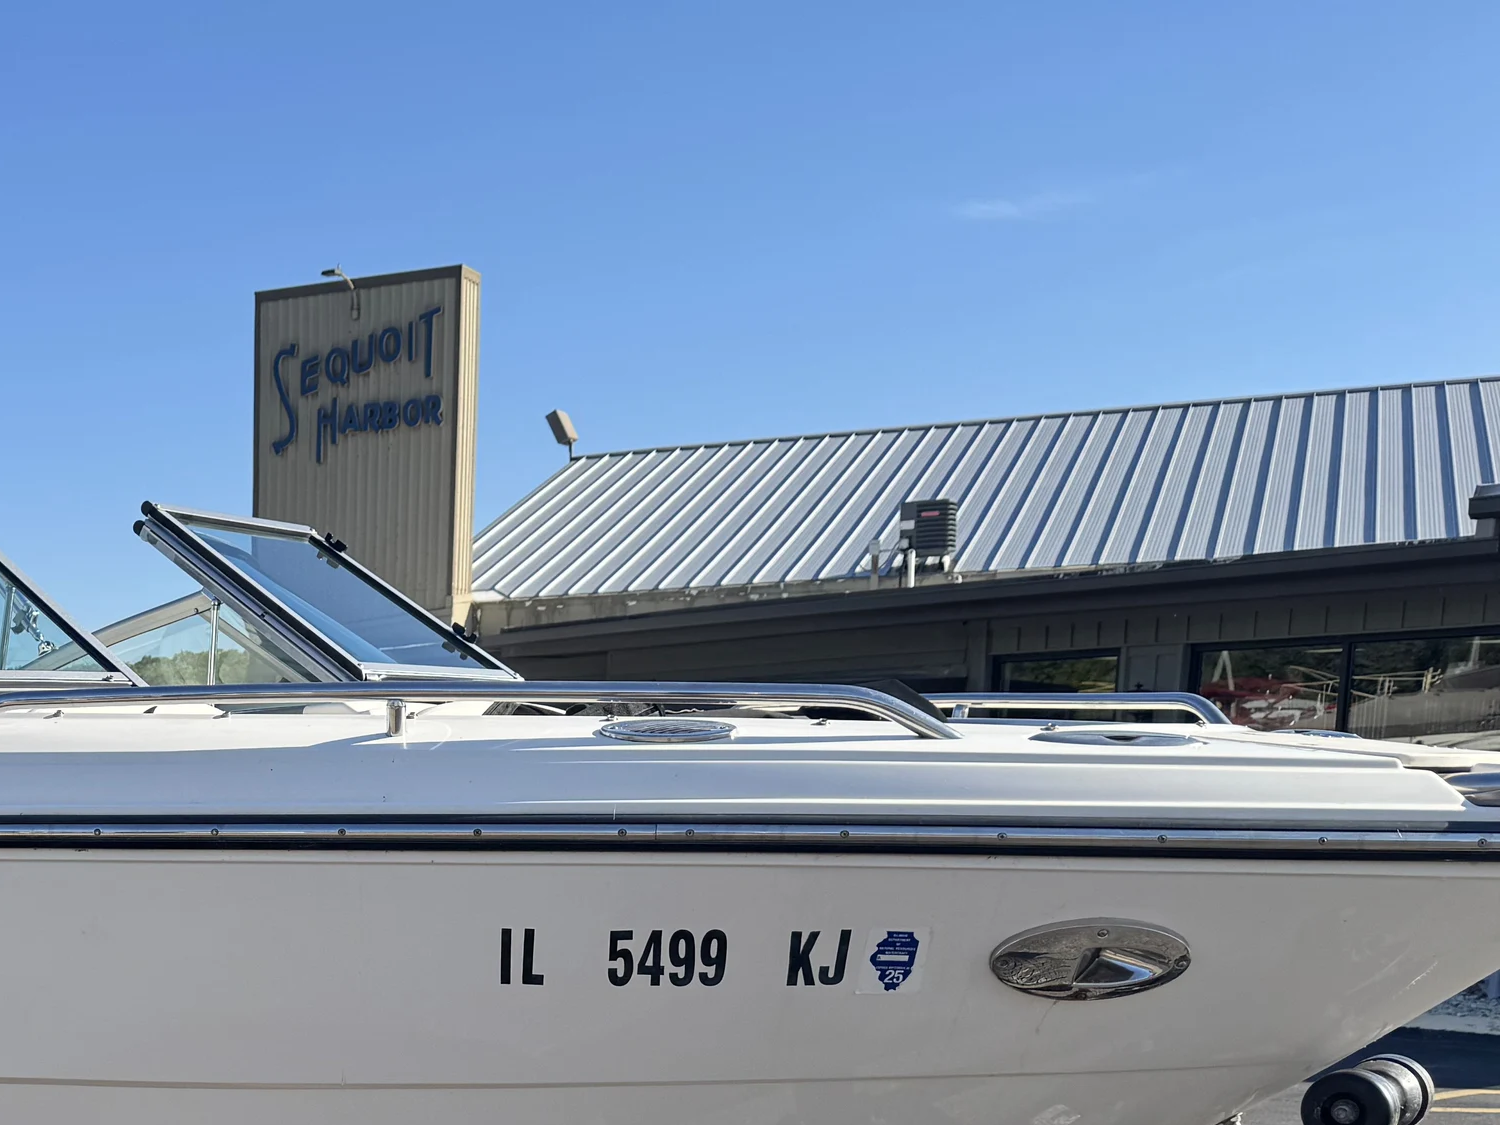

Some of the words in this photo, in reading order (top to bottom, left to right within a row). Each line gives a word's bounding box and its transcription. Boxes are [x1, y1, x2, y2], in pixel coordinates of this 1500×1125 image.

[271, 305, 443, 456] SEQUOIT
[315, 394, 443, 464] HARBOR
[500, 928, 544, 985] IL
[607, 929, 727, 987] 5499
[786, 929, 852, 987] KJ
[883, 969, 904, 983] 25
